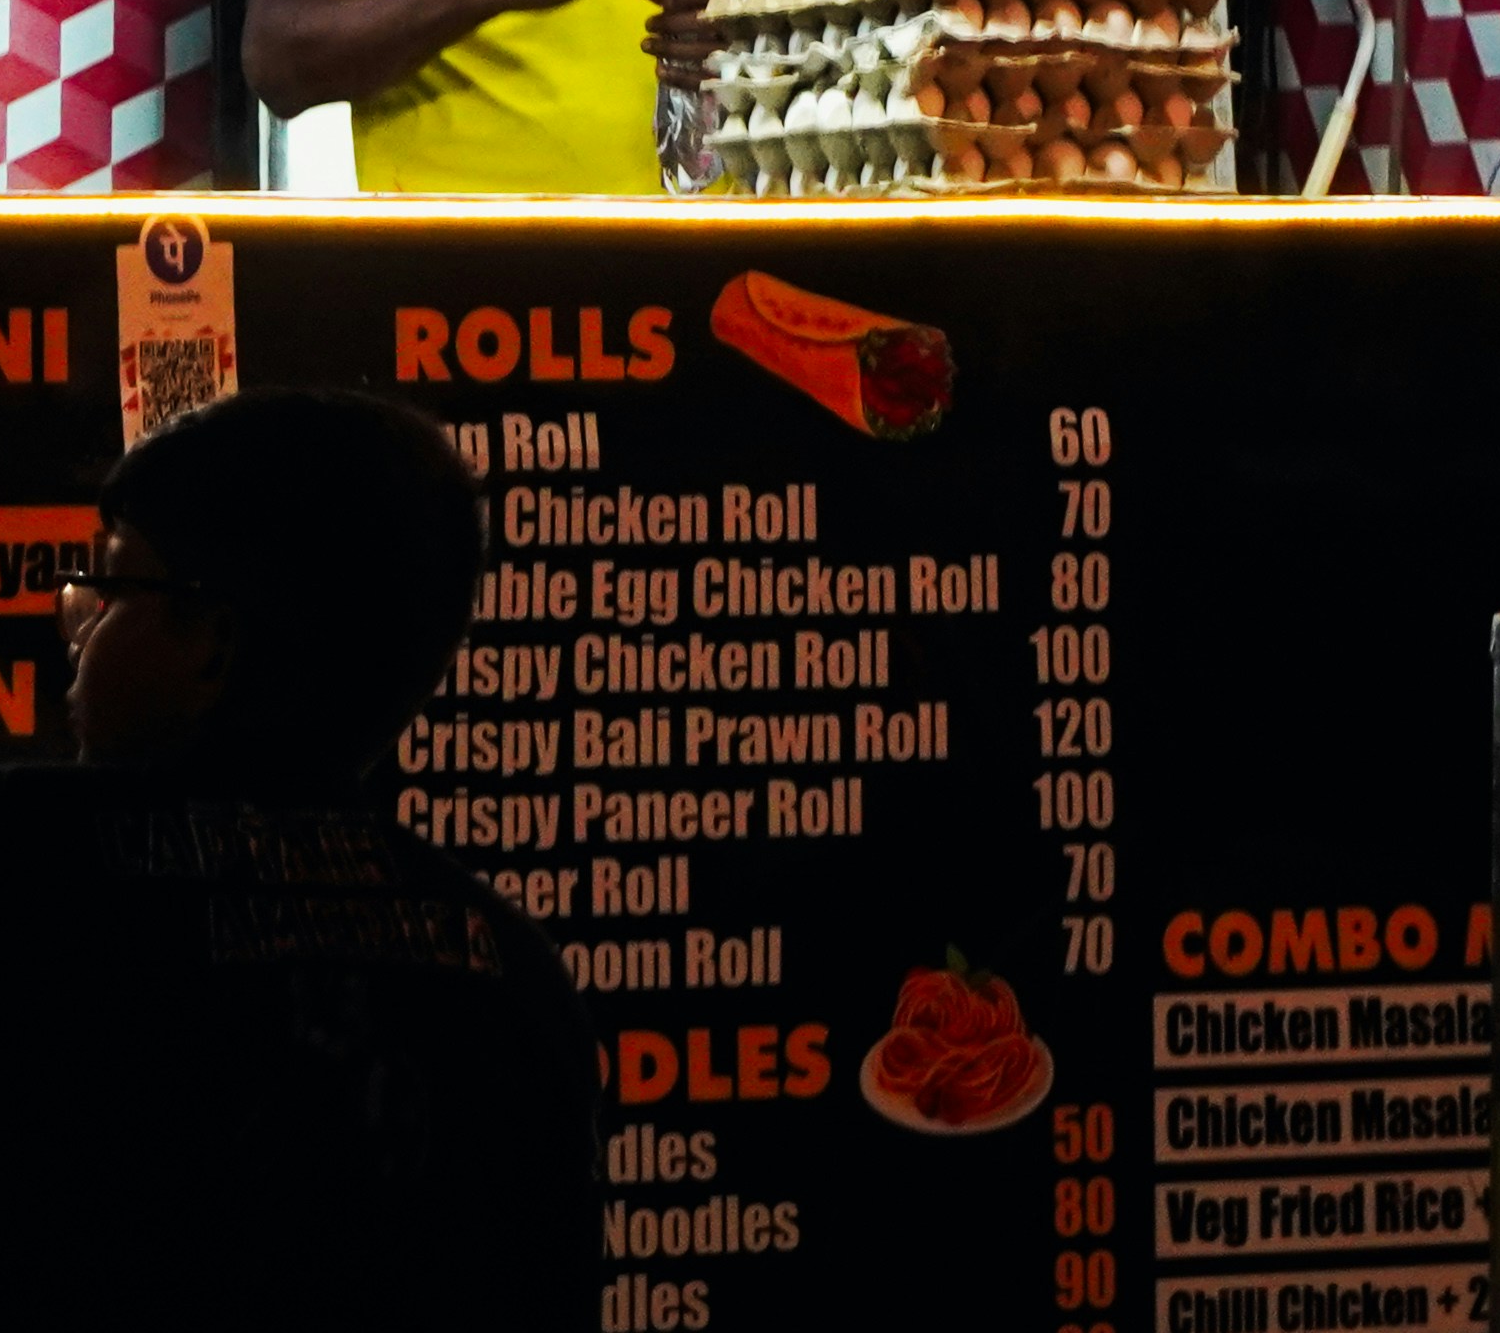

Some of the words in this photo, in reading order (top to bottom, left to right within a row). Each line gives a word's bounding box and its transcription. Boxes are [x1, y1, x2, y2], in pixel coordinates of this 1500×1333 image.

[395, 305, 677, 382] ROLLS
[503, 412, 601, 472] Roll
[1048, 405, 1113, 468] 60
[503, 483, 710, 548] Chicken
[722, 482, 818, 545] Roll
[1058, 478, 1113, 540] 70
[592, 557, 680, 628] Egg
[692, 555, 898, 619] Chicken
[909, 553, 1000, 615] Roll
[1050, 551, 1112, 614] 80
[573, 630, 782, 696] Chicken
[794, 629, 891, 690] Roll
[1028, 624, 1112, 687] 100
[398, 711, 561, 776] Crispy
[573, 705, 673, 770] Bali
[686, 704, 843, 767] Prawn
[854, 701, 951, 762] Roll
[1032, 696, 1113, 760] 120
[398, 784, 561, 853] Crispy
[573, 781, 756, 845] Paneer
[767, 776, 865, 839] Roll
[1032, 767, 1115, 831] 100
[591, 854, 692, 918] Roll
[1061, 841, 1116, 904] 70
[685, 926, 783, 990] Roll
[1060, 913, 1116, 976] 70
[1161, 903, 1442, 980] COMBO
[1166, 996, 1340, 1057] Chicken
[1350, 992, 1492, 1049] Masala
[1052, 1099, 1117, 1166] 50
[1167, 1088, 1341, 1149] Chicken
[1351, 1085, 1492, 1141] Masala
[602, 1194, 801, 1261] Noodles
[1052, 1173, 1118, 1240] 80
[1167, 1190, 1248, 1247] Veg
[1260, 1185, 1364, 1241] Fried
[1375, 1181, 1465, 1235] Rice
[1054, 1246, 1119, 1315] 90
[1278, 1281, 1428, 1332] Chicken
